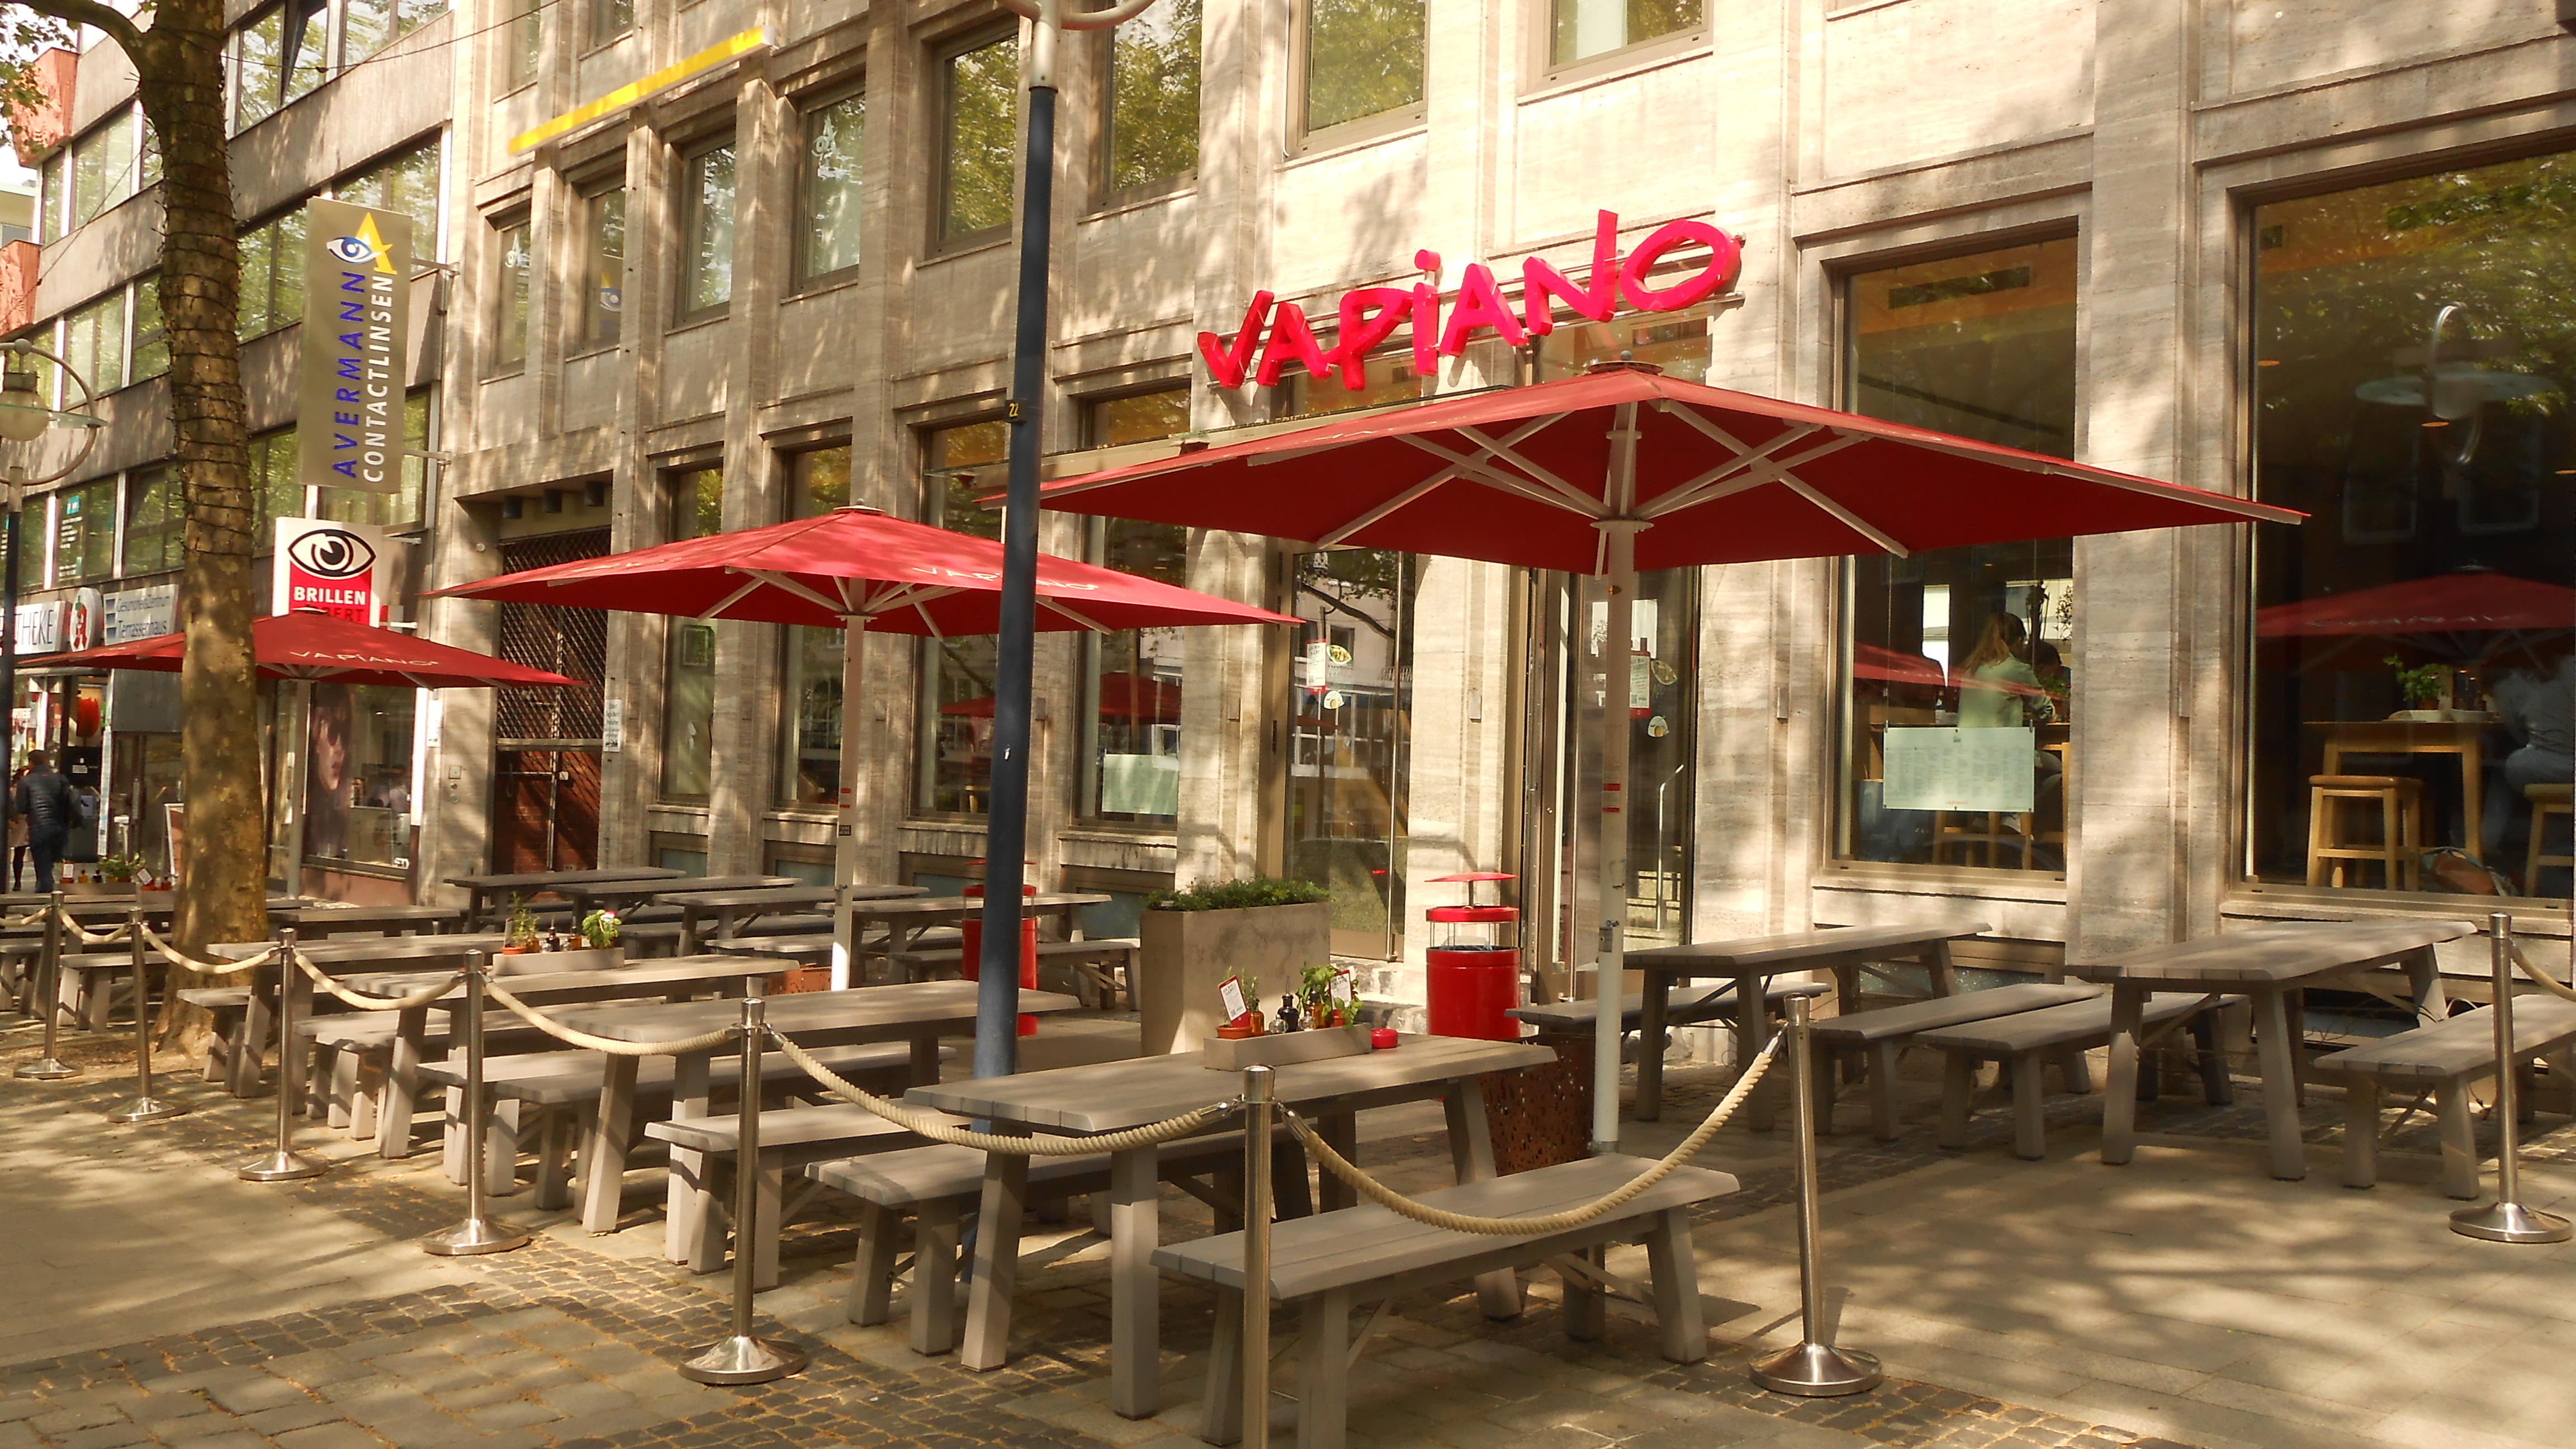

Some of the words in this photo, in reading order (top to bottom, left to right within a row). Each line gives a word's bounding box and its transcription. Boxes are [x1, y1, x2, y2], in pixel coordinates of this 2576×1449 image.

[333, 271, 366, 479] AVERMANN
[364, 276, 394, 482] CONTACTLINSEN
[1009, 402, 1019, 417] 22
[293, 586, 367, 605] BRILLEN
[14, 609, 55, 646] THEKE
